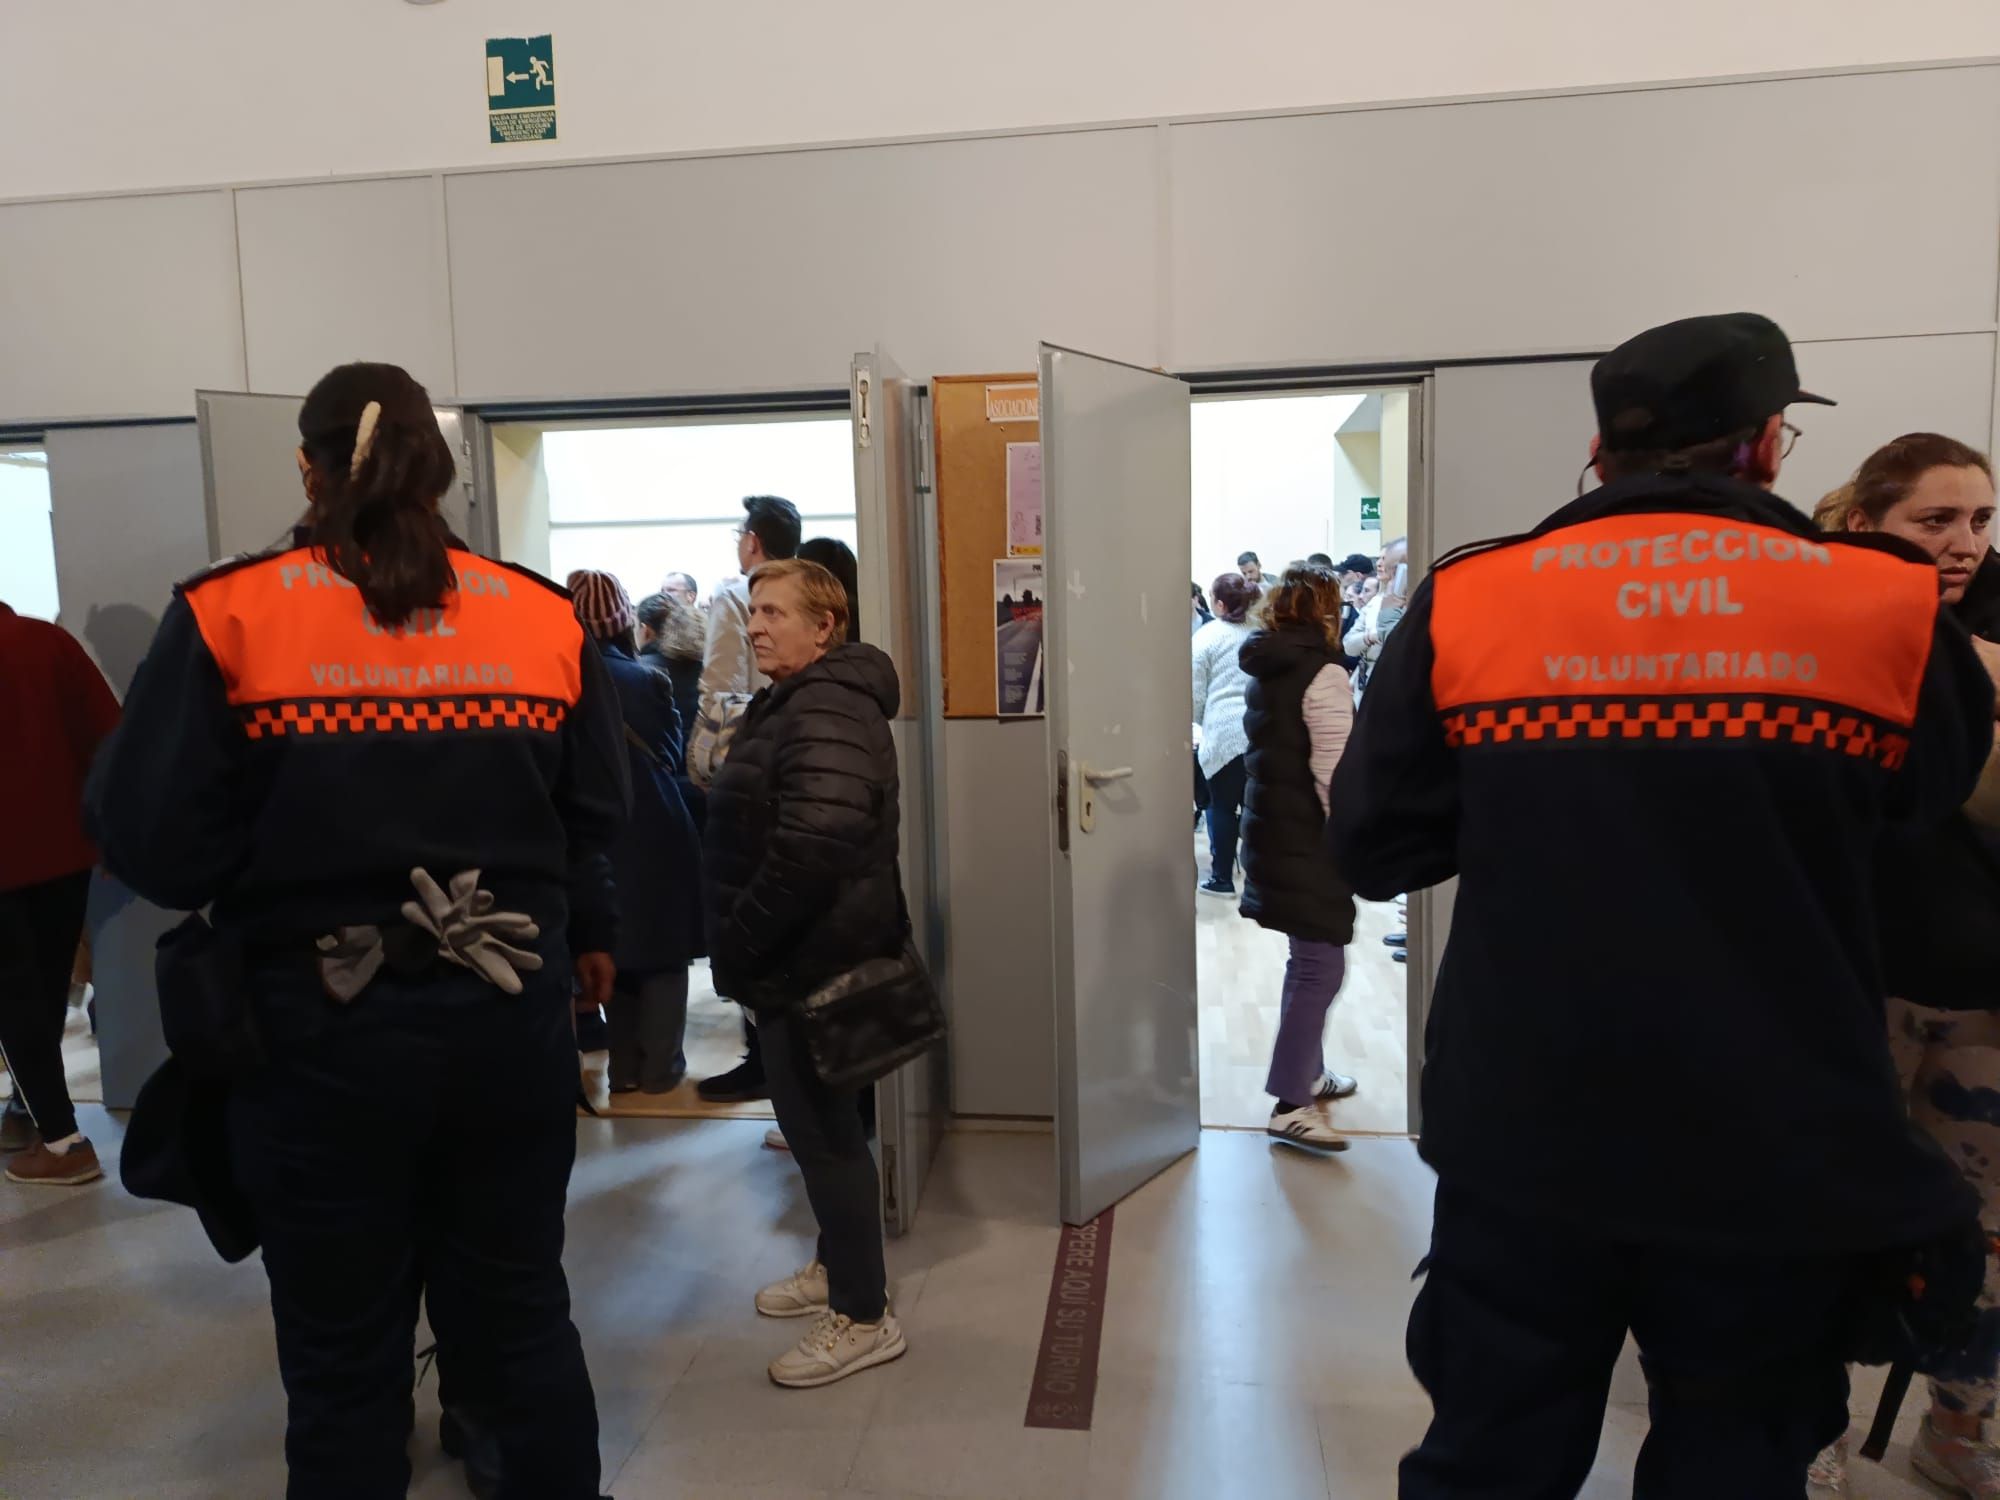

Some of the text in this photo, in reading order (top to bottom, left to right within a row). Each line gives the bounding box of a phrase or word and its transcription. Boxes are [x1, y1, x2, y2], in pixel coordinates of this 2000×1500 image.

[1531, 530, 1832, 572] PROTECCION
[1616, 576, 1744, 618] CIVIL
[362, 606, 457, 638] CVIL
[310, 663, 514, 688] VOLUNTARIADO
[1544, 651, 1818, 682] VOLUNTARIADO
[1066, 1218, 1099, 1268] SPERE
[1056, 1307, 1088, 1329] SU
[1044, 1334, 1084, 1394] TURNO
